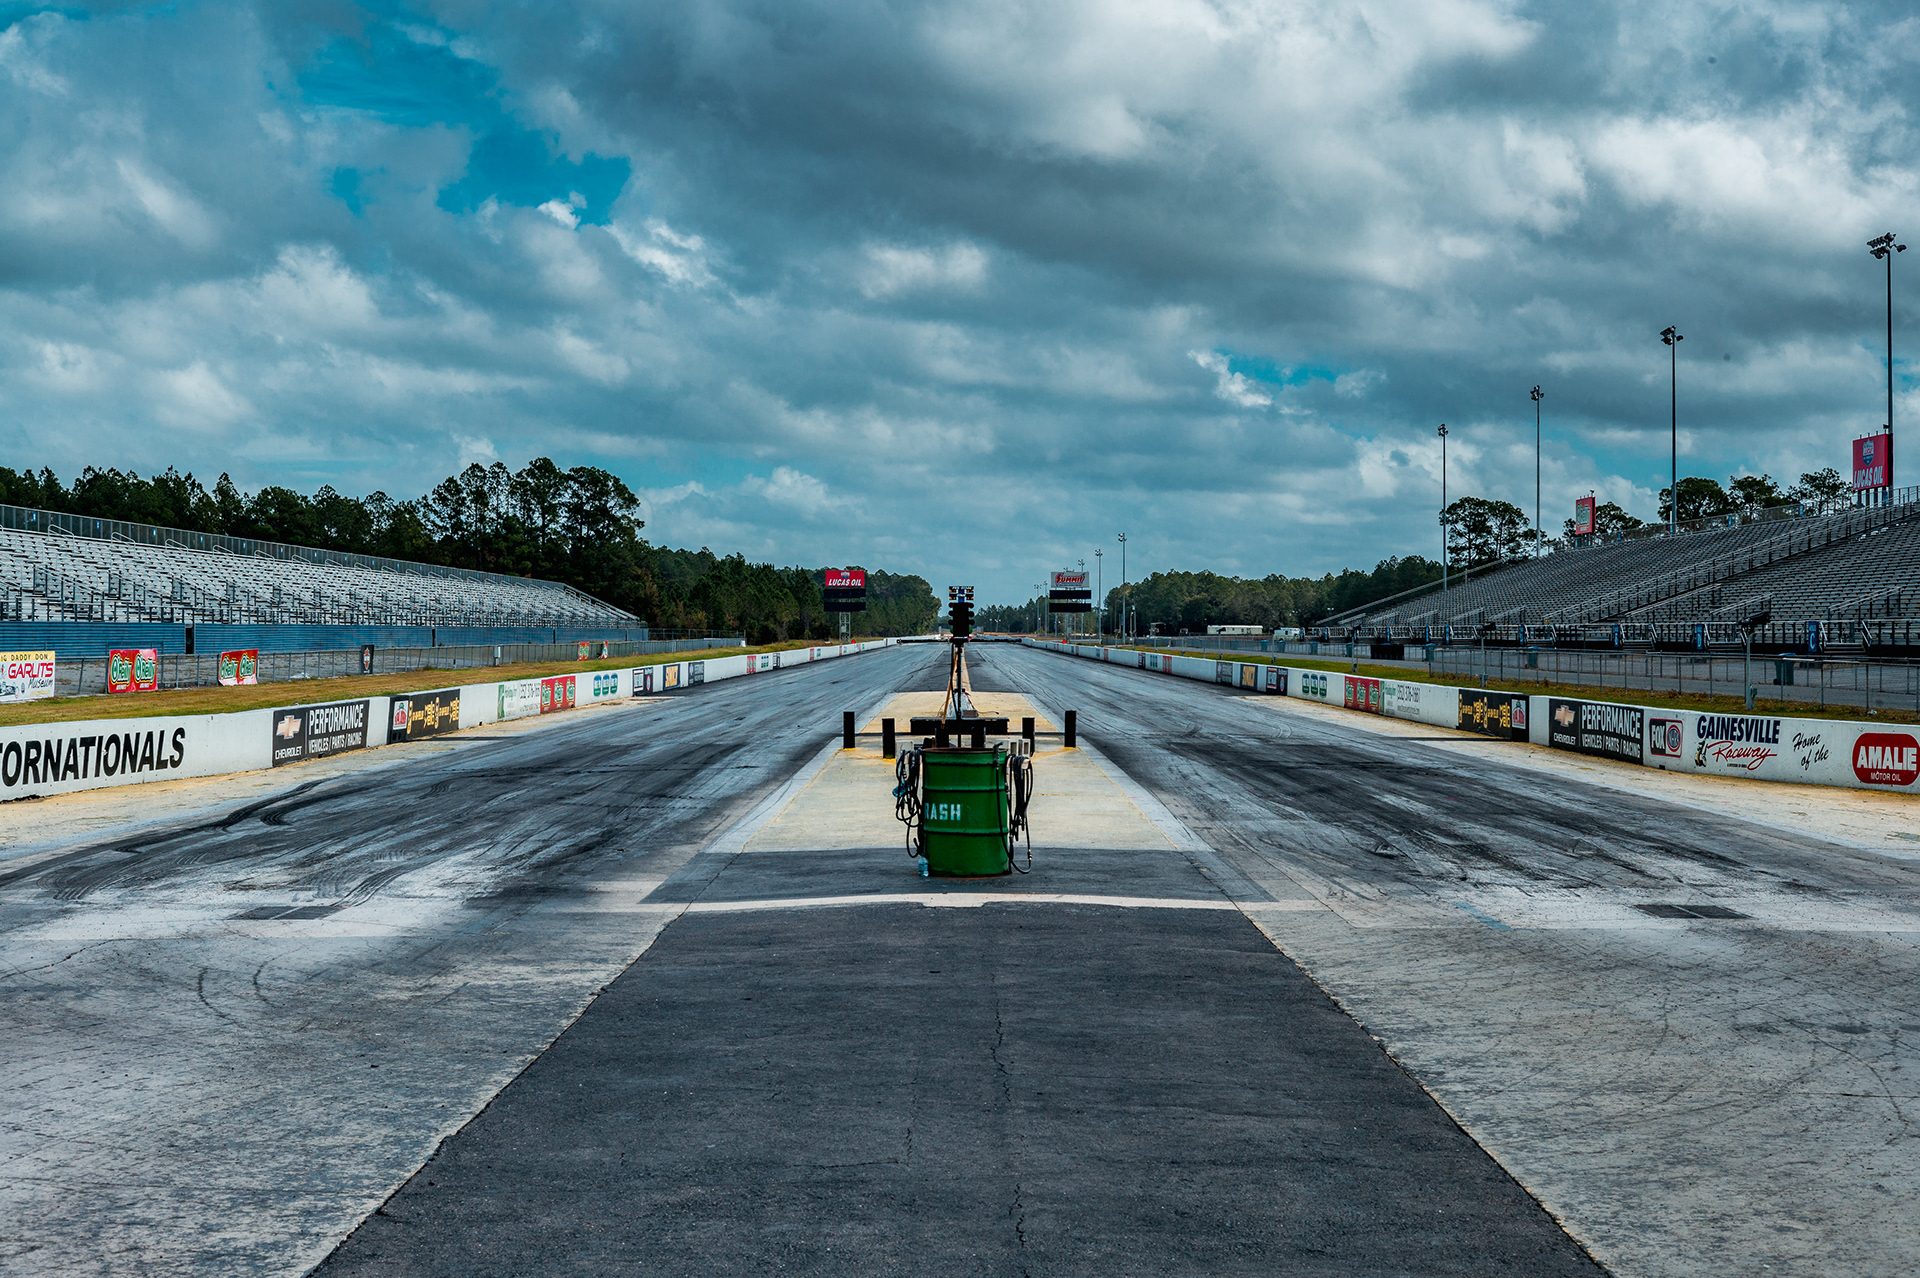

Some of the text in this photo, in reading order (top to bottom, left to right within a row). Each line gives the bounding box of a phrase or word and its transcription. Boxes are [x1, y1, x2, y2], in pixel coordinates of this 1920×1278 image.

[1853, 465, 1883, 489] LUCAS OIL
[828, 578, 862, 586] LUCAS OIL
[11, 653, 31, 661] DADDY
[8, 662, 54, 679] GARLITS
[28, 677, 53, 689] Museum
[308, 704, 364, 736] PERFORMANCE
[1581, 704, 1640, 740] PERFORMANCE
[1697, 715, 1781, 744] GAINESVILLE
[308, 737, 329, 754] VEHICLES
[332, 734, 345, 750] PARTS
[348, 731, 362, 749] RACING
[1553, 732, 1577, 746] CHEVROLET
[1581, 733, 1602, 749] VEHICLES
[1605, 735, 1619, 753] PARTS
[1622, 739, 1640, 758] RACING
[1651, 725, 1665, 749] FOX
[1792, 732, 1821, 752] Home
[0, 727, 186, 788] ORNATIONALS
[275, 746, 302, 760] CHEVROLET
[1706, 740, 1778, 771] Raceway
[1800, 744, 1829, 771] of the
[1856, 745, 1918, 771] AMALIE
[1870, 772, 1902, 782] MOTOR OIL
